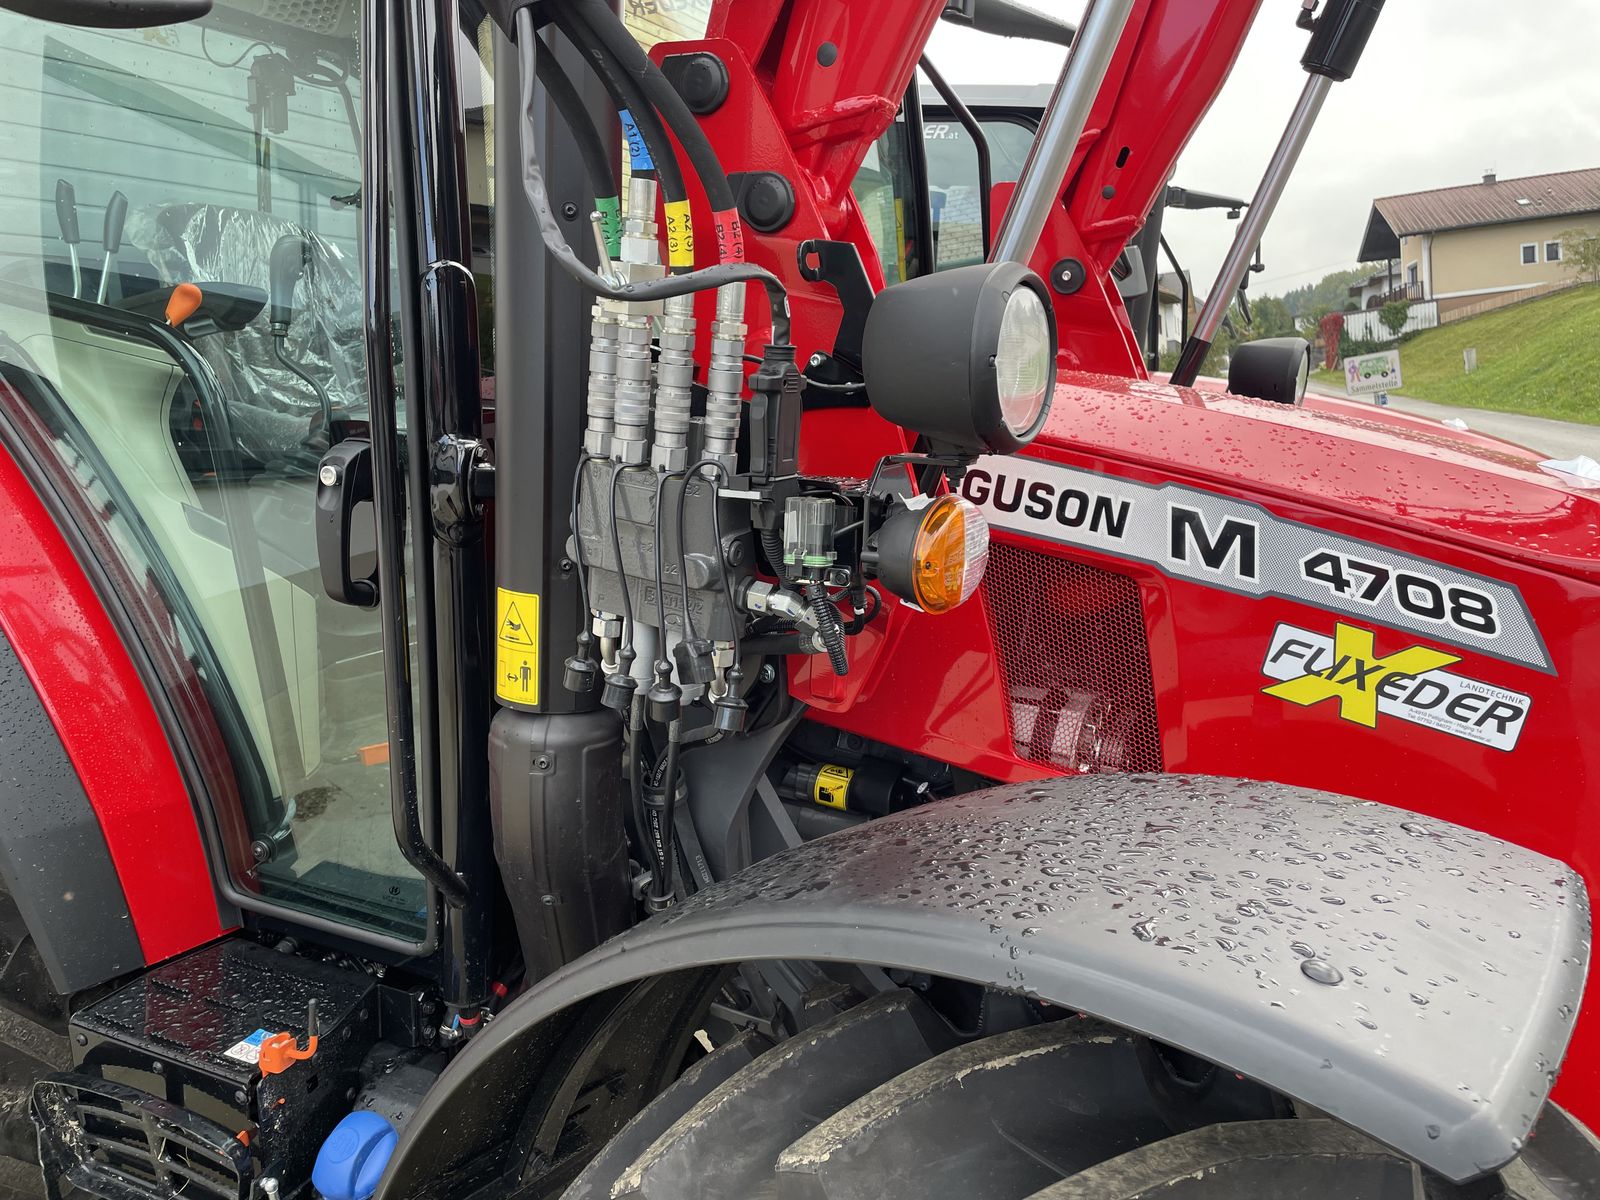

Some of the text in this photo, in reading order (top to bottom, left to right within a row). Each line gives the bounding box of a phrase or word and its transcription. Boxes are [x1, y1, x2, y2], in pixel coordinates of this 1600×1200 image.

[1350, 379, 1399, 394] Sammelstelle
[960, 468, 1497, 635] GUSON M 4708
[1269, 638, 1525, 735] FLIXEDER
[1459, 680, 1526, 706] LANDTECHNIK
